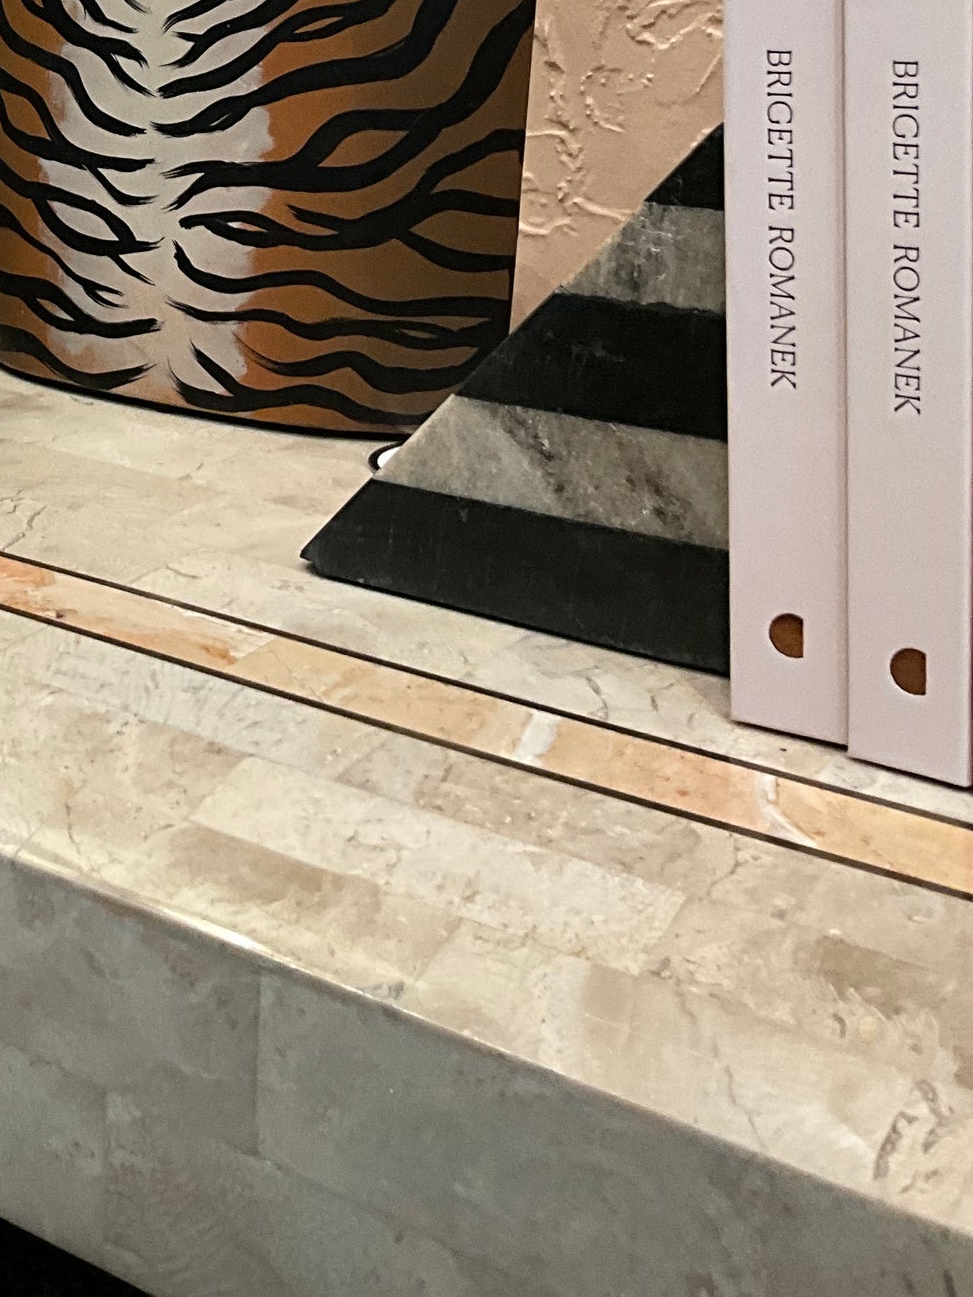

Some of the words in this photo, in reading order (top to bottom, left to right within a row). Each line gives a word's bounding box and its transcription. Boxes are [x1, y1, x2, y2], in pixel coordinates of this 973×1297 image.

[766, 49, 795, 211] BRIGETTE
[892, 60, 921, 229] BRIGETTE
[767, 225, 798, 390] ROMANEK
[892, 243, 922, 416] ROMANEK
